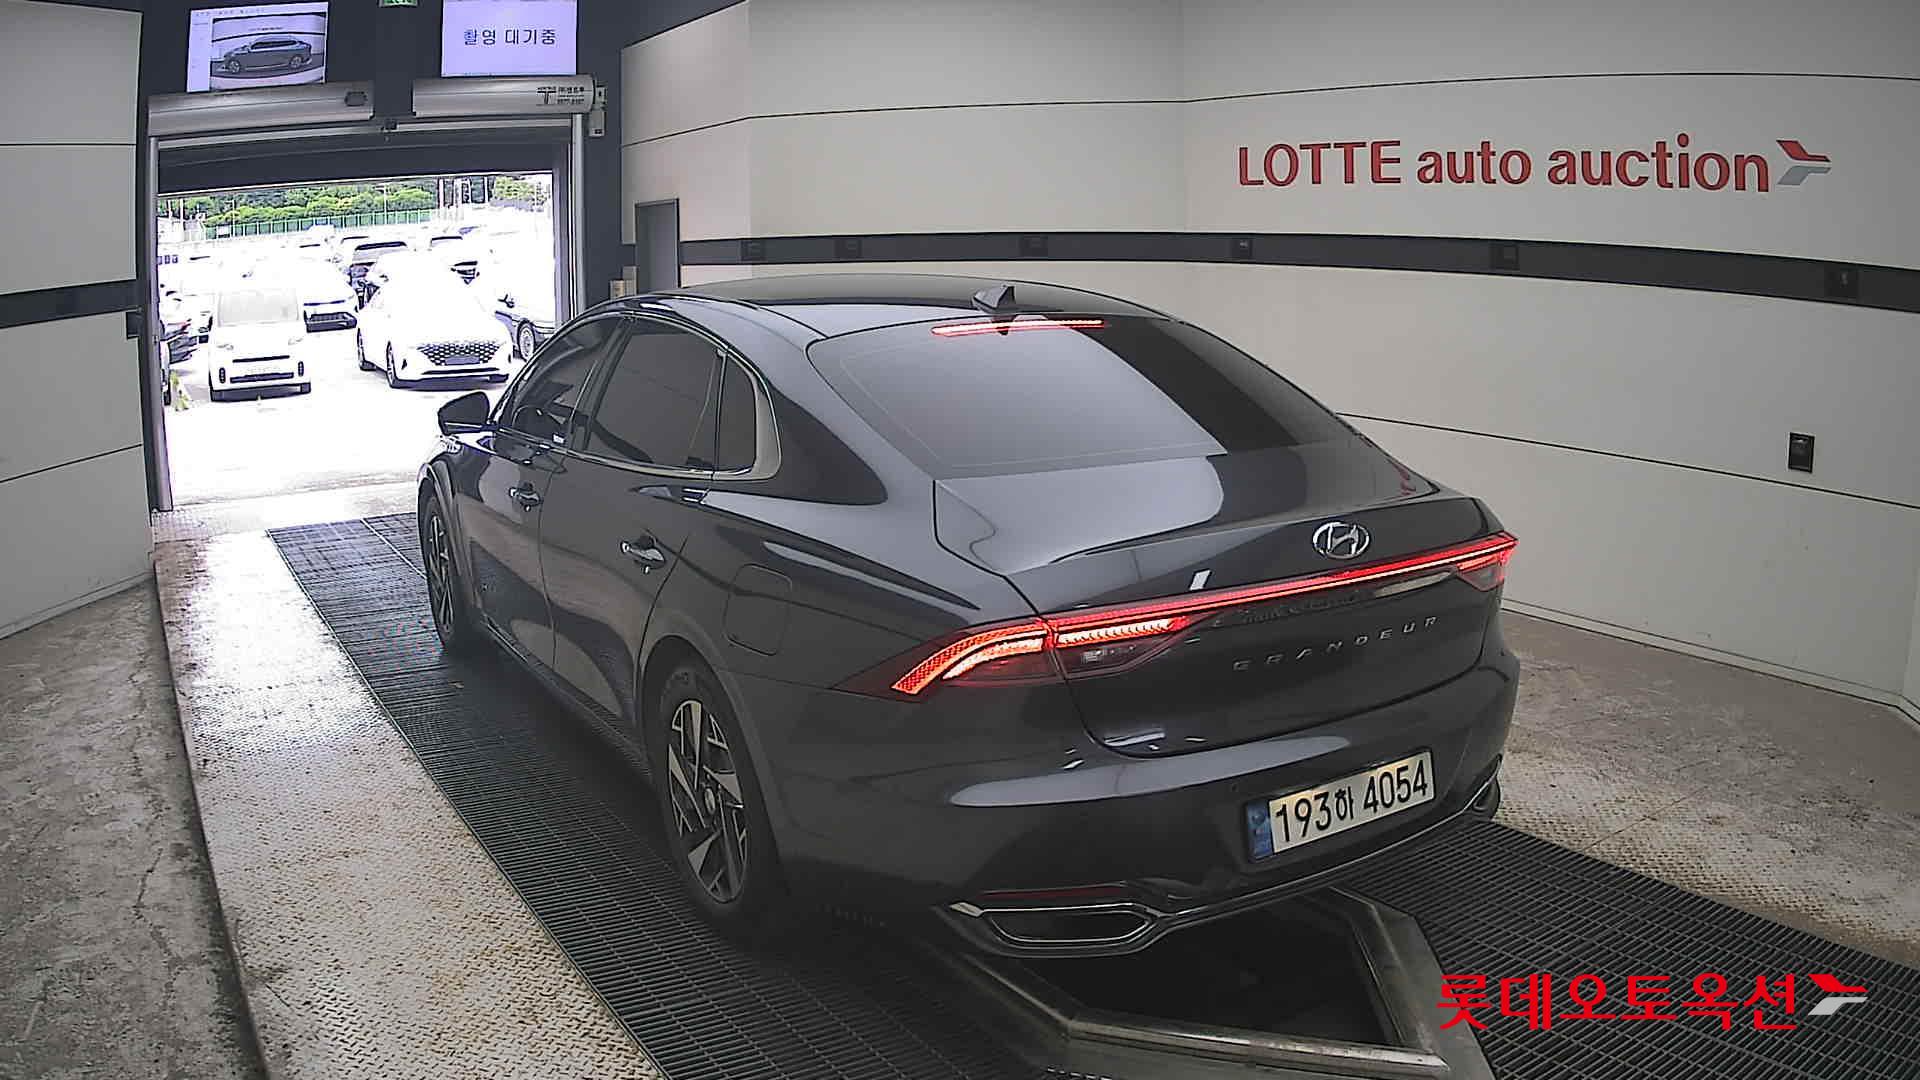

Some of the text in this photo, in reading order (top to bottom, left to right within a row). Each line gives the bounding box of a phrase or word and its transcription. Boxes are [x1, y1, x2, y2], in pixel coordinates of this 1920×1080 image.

[504, 28, 557, 46] 대기중
[1239, 133, 1770, 193] LOTTE auto auction
[1232, 615, 1438, 672] GRANDEUR
[1275, 759, 1428, 843] 193하 4054
